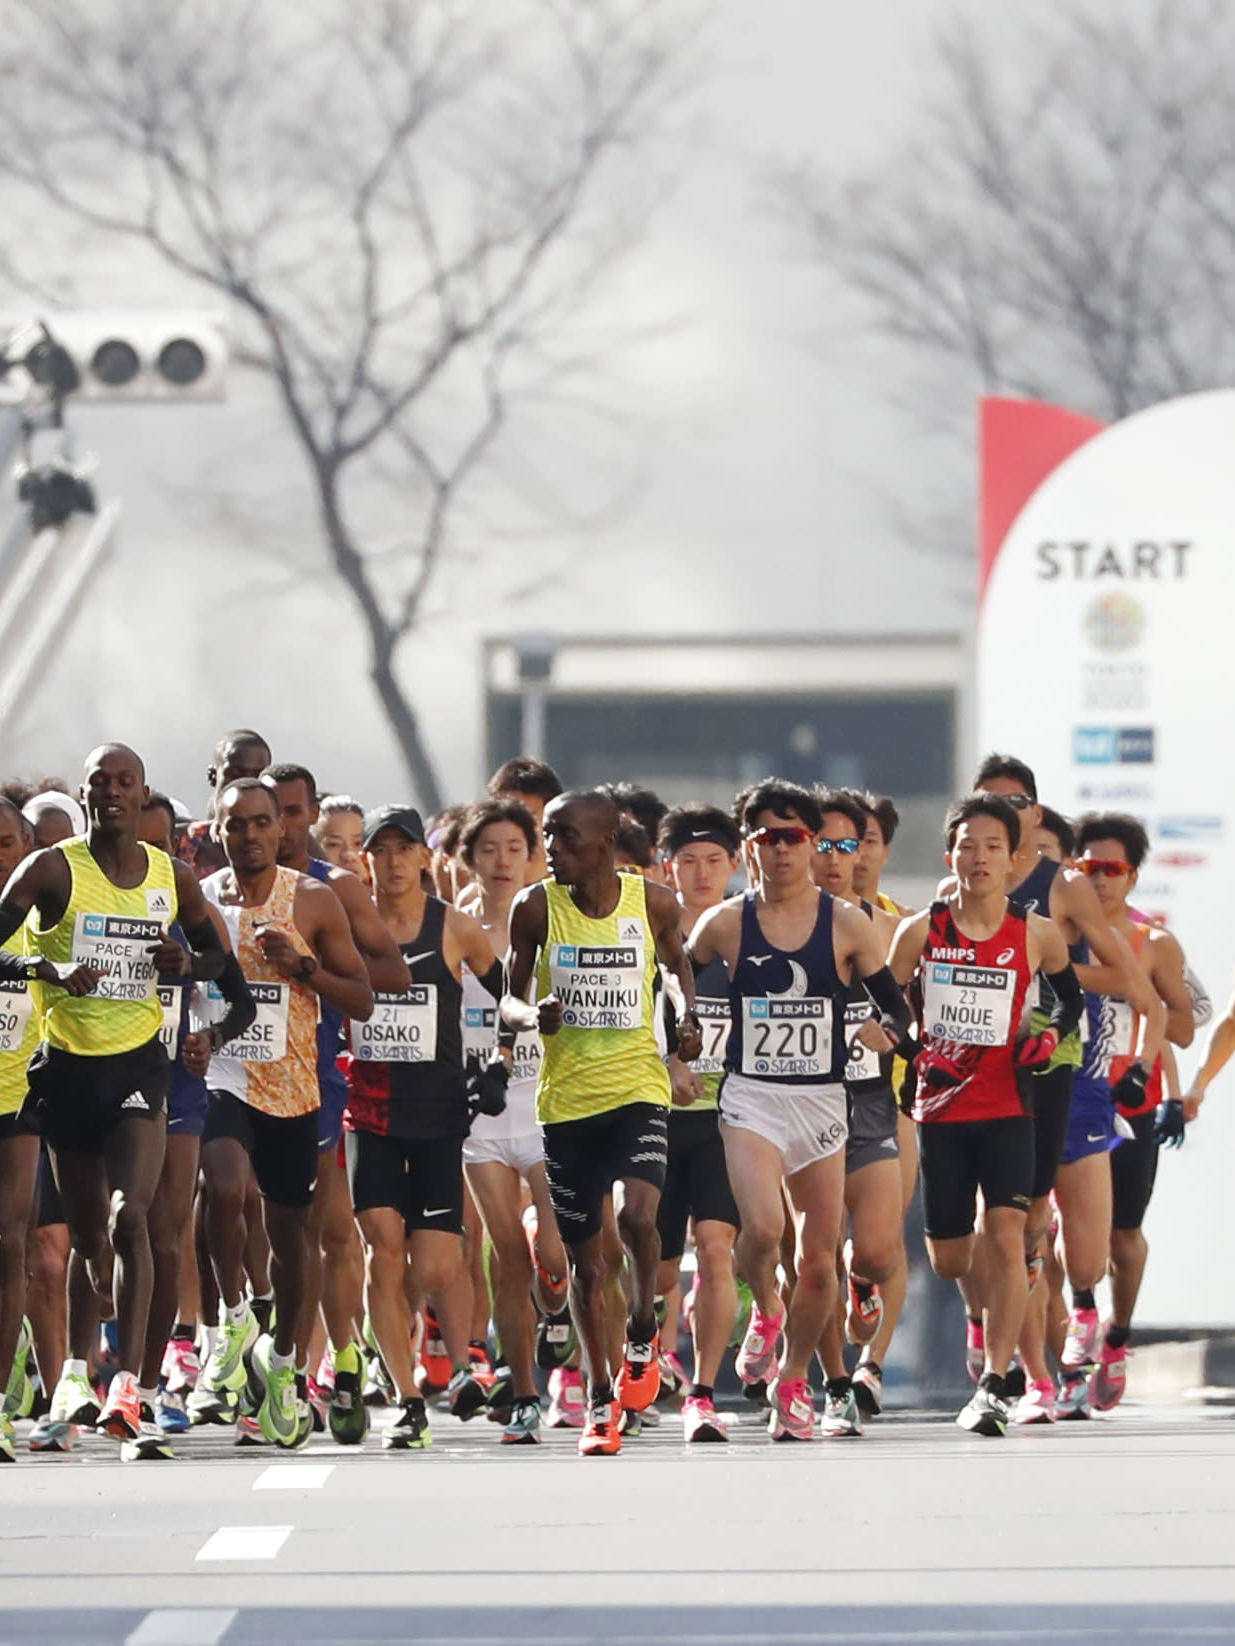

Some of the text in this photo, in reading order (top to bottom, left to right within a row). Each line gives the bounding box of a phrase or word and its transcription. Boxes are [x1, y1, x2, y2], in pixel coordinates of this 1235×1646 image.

[1036, 540, 1194, 580] START
[109, 922, 159, 936] 東京メトロ
[95, 942, 133, 957] PACE
[931, 947, 975, 961] MHPS
[581, 951, 634, 965] 東京メトロ
[570, 974, 622, 986] PACE 3
[954, 971, 1005, 986] 東京メトロ
[249, 988, 278, 1000] メトロ
[556, 986, 639, 1008] WANJIKU
[959, 989, 977, 1005] 23
[5, 1000, 12, 1010] 4
[771, 1003, 823, 1015] 東京メトロ
[382, 1008, 398, 1023] 21
[940, 1004, 993, 1027] INOUE
[362, 1024, 421, 1042] OSAKO
[754, 1022, 817, 1058] 220
